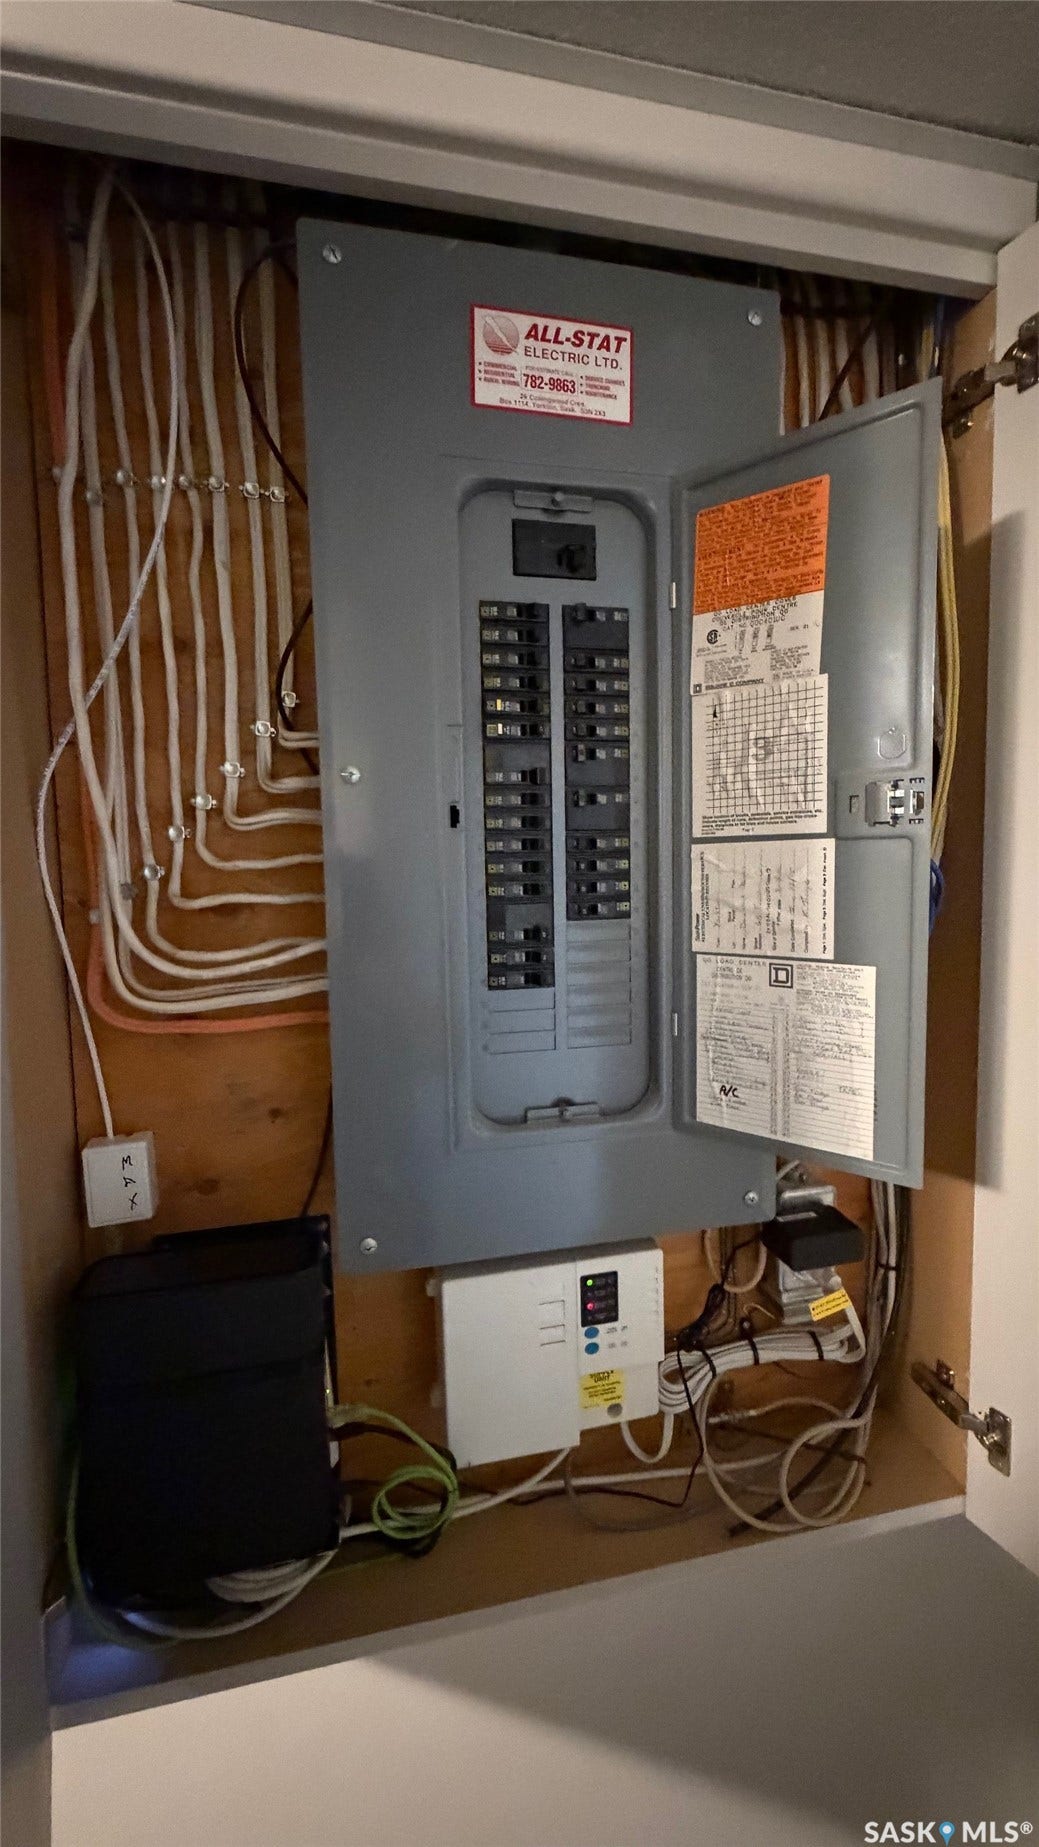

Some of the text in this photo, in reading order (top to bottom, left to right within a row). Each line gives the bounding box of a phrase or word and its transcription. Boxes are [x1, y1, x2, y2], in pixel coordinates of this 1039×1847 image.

[524, 323, 627, 354] ALL-STAT
[524, 346, 623, 371] ELECTRIC LTD.
[522, 373, 576, 394] 782-9863
[719, 1084, 740, 1099] A/C
